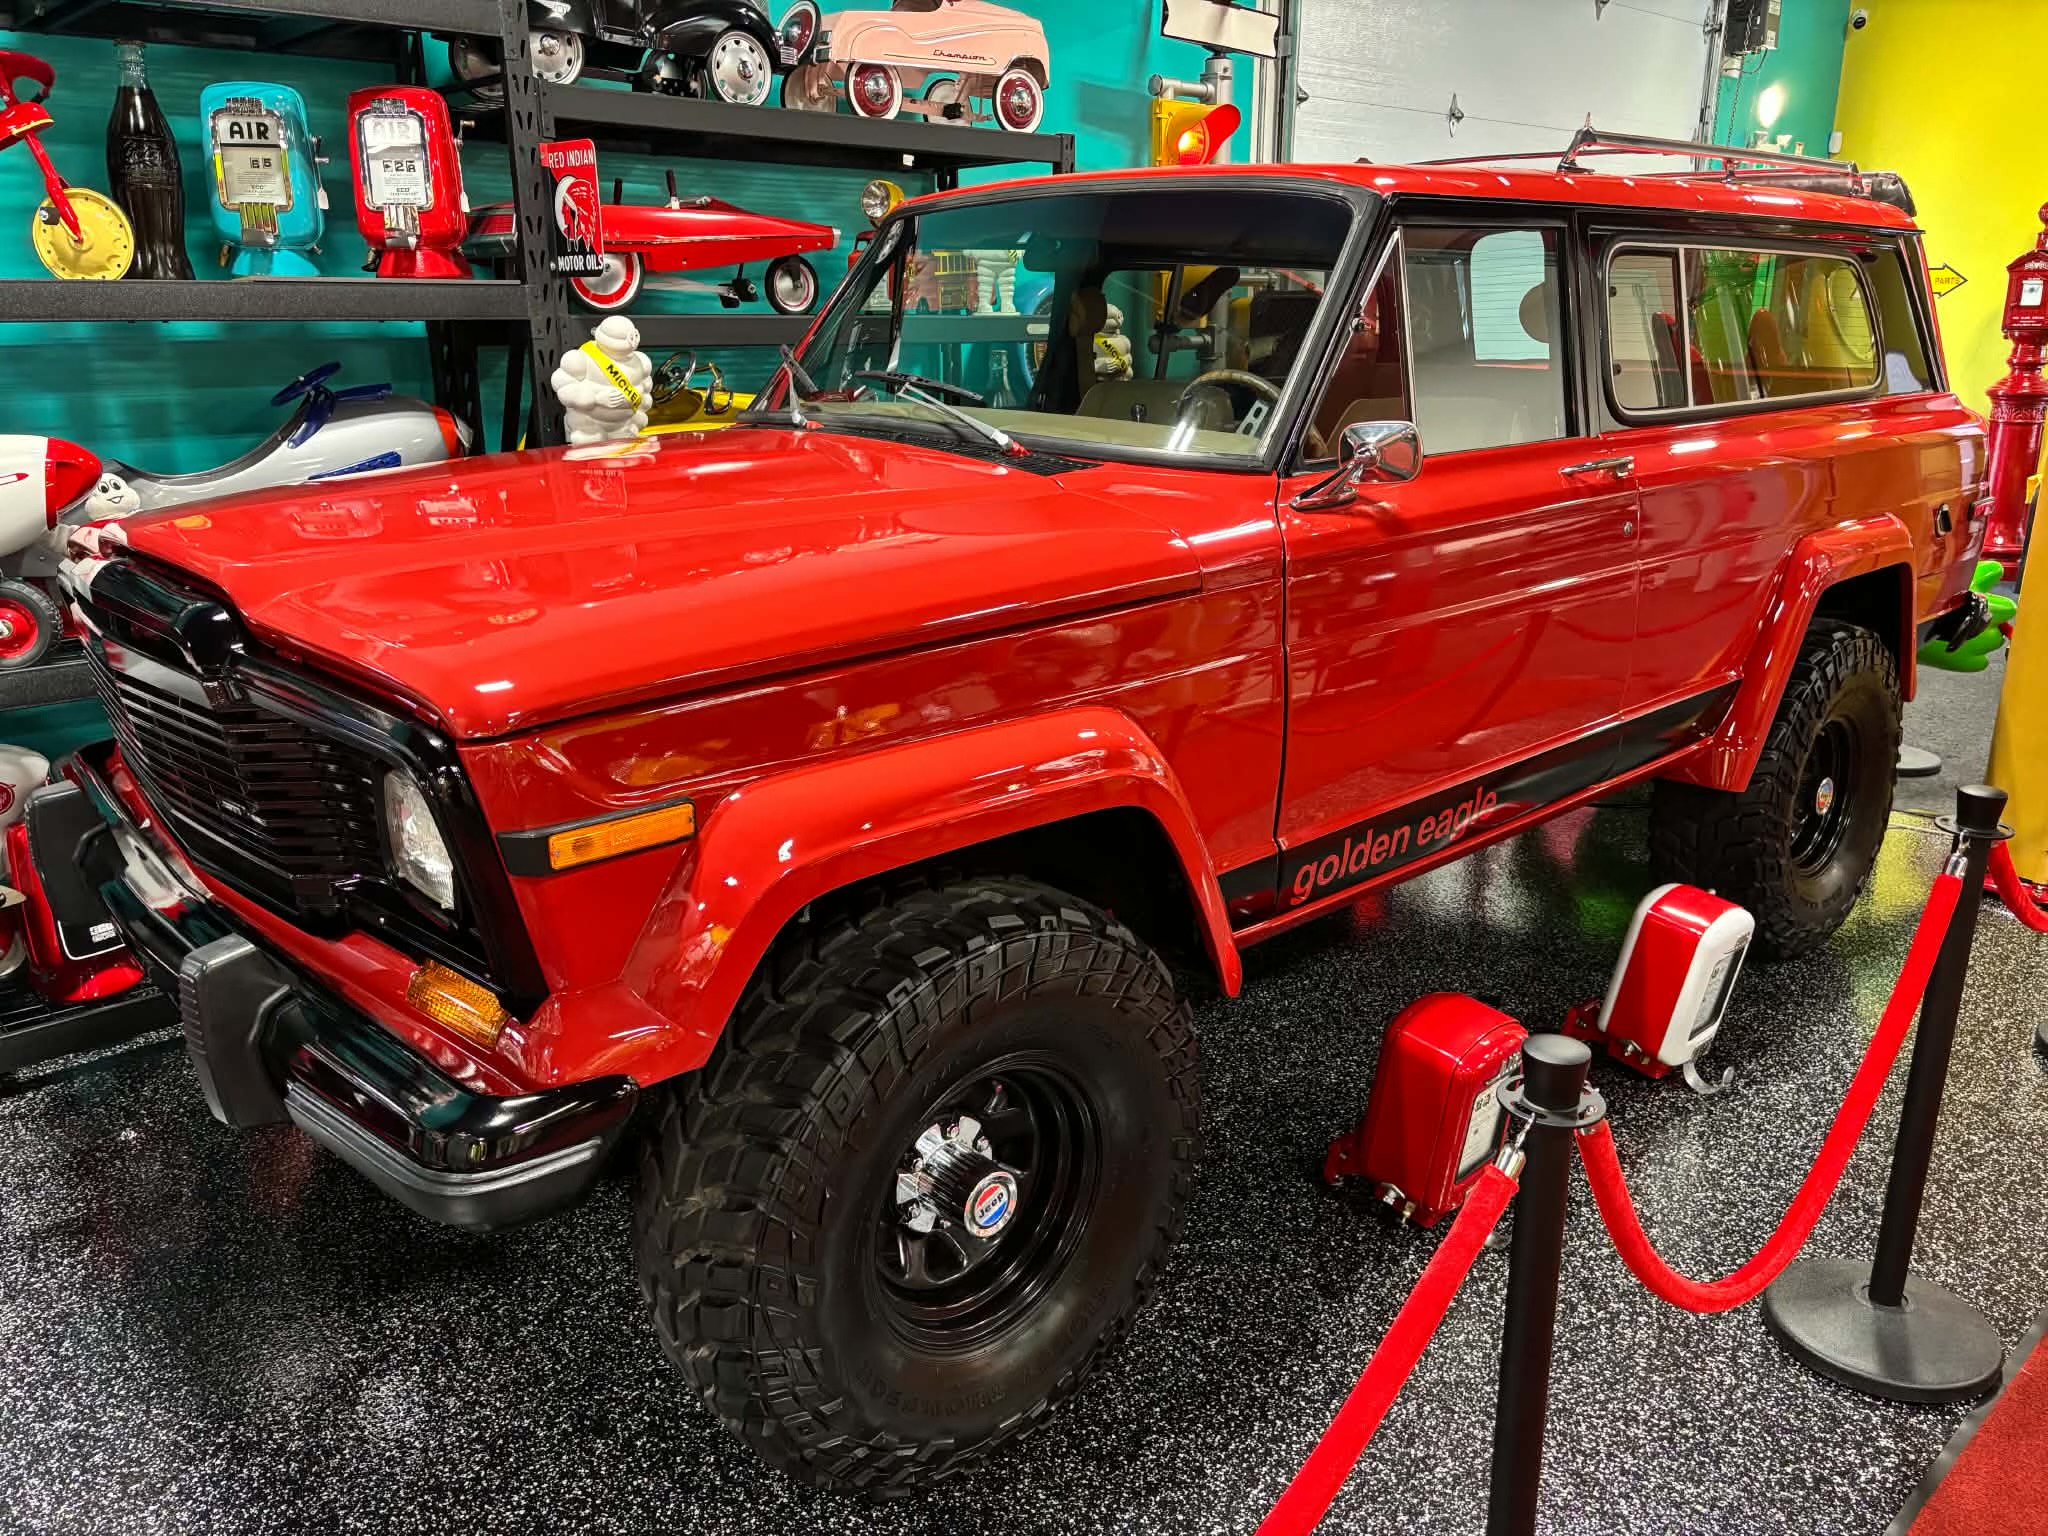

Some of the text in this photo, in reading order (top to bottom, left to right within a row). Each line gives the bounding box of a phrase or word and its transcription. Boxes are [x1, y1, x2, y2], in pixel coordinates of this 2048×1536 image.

[933, 49, 987, 60] Champion
[229, 121, 269, 140] AIR
[549, 149, 594, 168] RED INDIAN
[558, 254, 604, 271] MOTOR OILS
[1290, 786, 1497, 905] golden eagle
[979, 1192, 1004, 1218] Jeep
